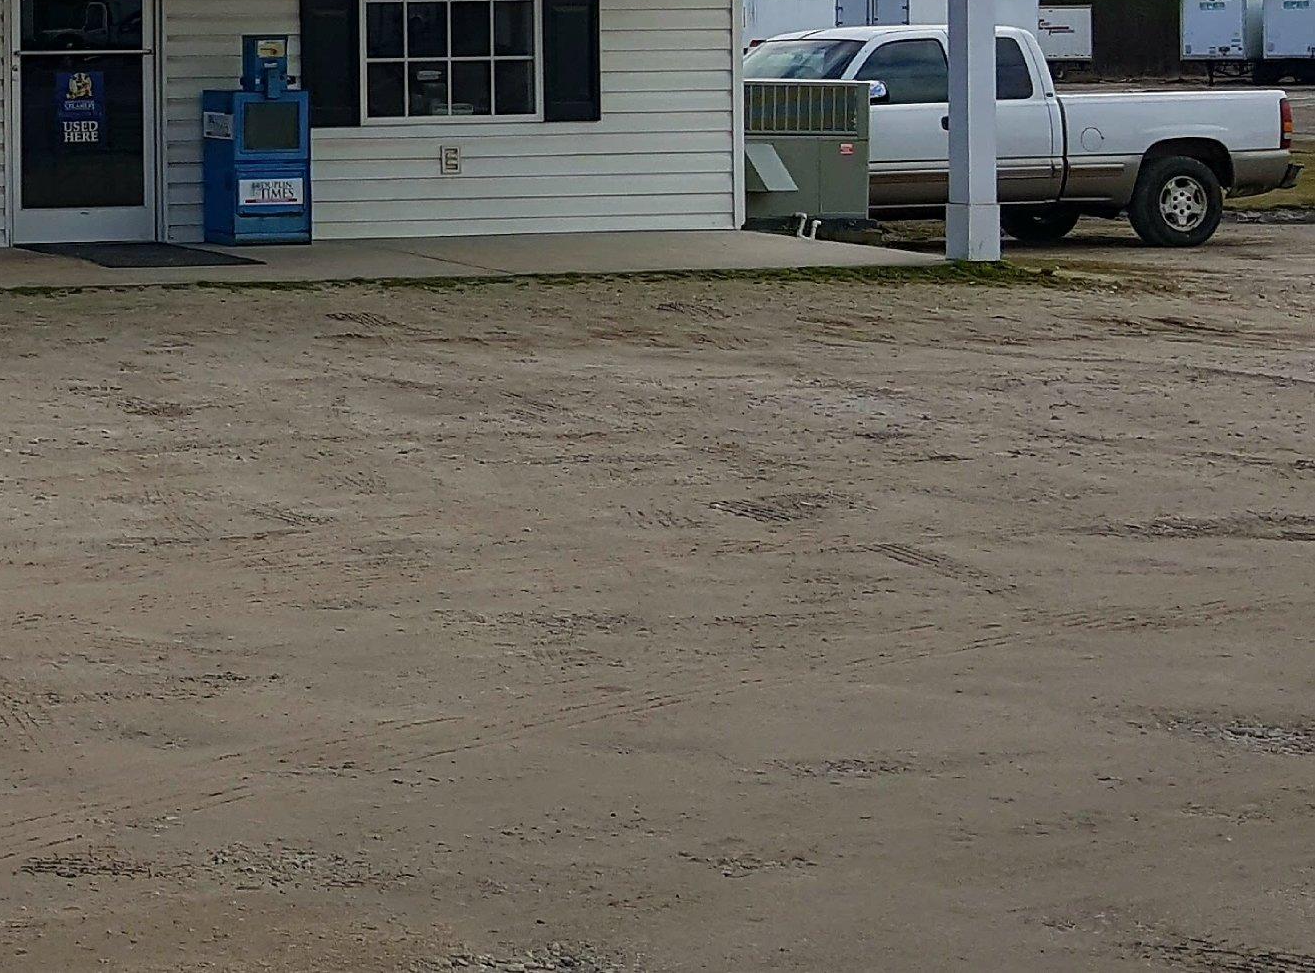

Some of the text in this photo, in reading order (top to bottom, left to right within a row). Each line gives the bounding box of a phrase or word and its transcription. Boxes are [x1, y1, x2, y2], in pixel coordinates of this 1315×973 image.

[63, 121, 99, 132] USED
[64, 132, 99, 142] HERE
[259, 187, 294, 199] TIMES
